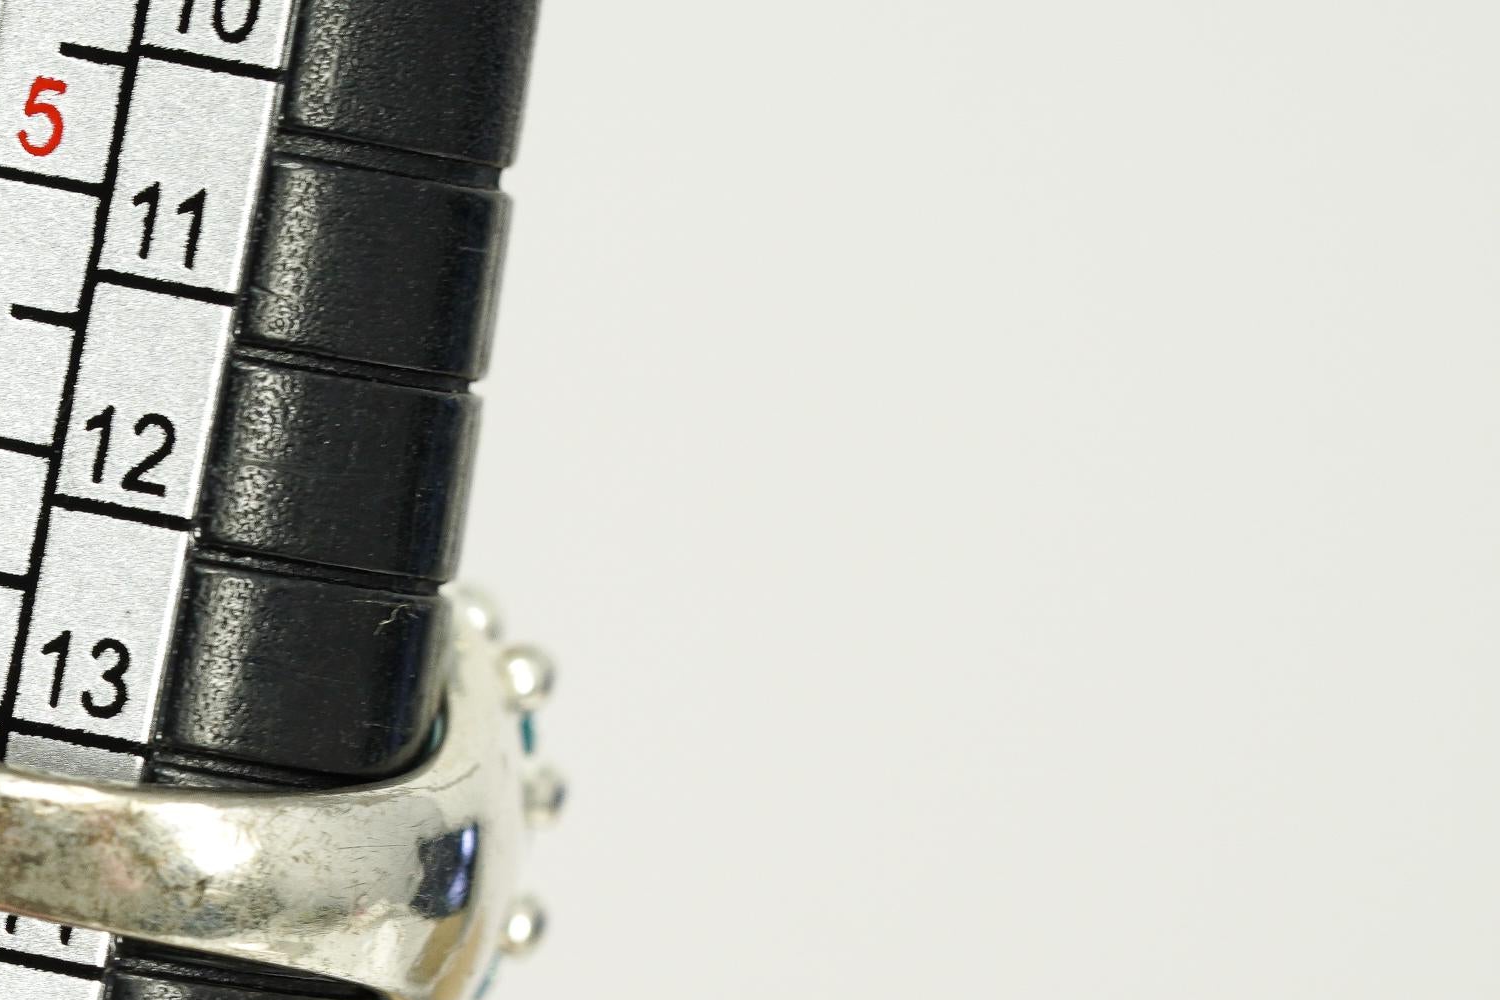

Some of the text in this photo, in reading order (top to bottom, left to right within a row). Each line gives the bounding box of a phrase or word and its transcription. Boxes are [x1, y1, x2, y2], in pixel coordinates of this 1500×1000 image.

[17, 75, 68, 157] 5
[131, 180, 208, 270] 11
[85, 404, 177, 498] 12
[40, 629, 131, 720] 13
